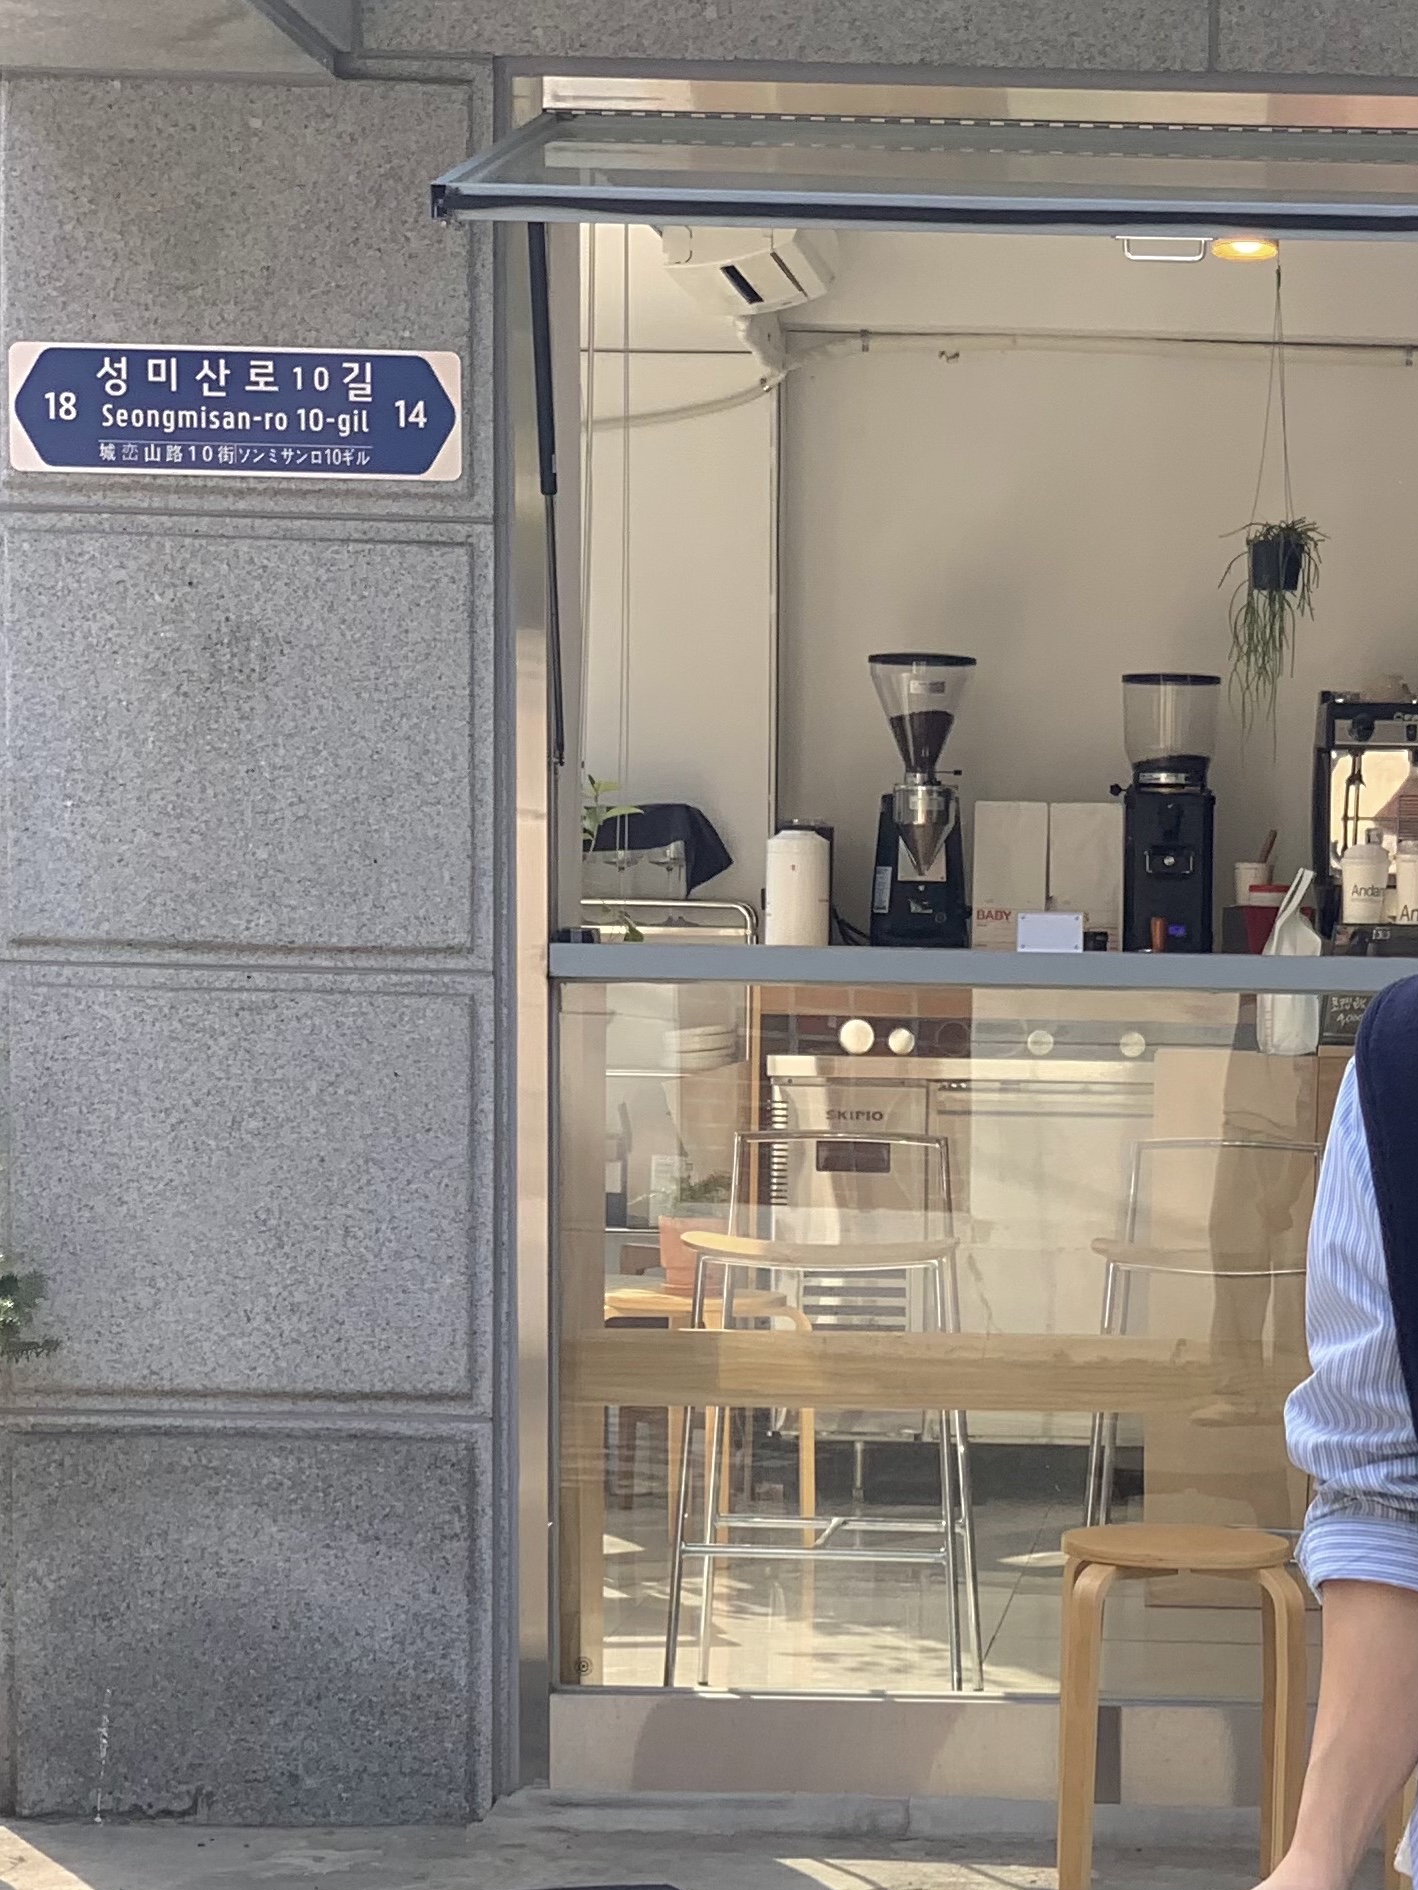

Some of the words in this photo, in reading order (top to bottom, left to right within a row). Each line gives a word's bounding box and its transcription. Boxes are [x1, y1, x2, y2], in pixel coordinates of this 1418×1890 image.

[44, 391, 77, 420] 18
[394, 400, 427, 428] 14
[102, 404, 288, 433] Seongmisan-ro
[297, 408, 369, 437] 10-gil
